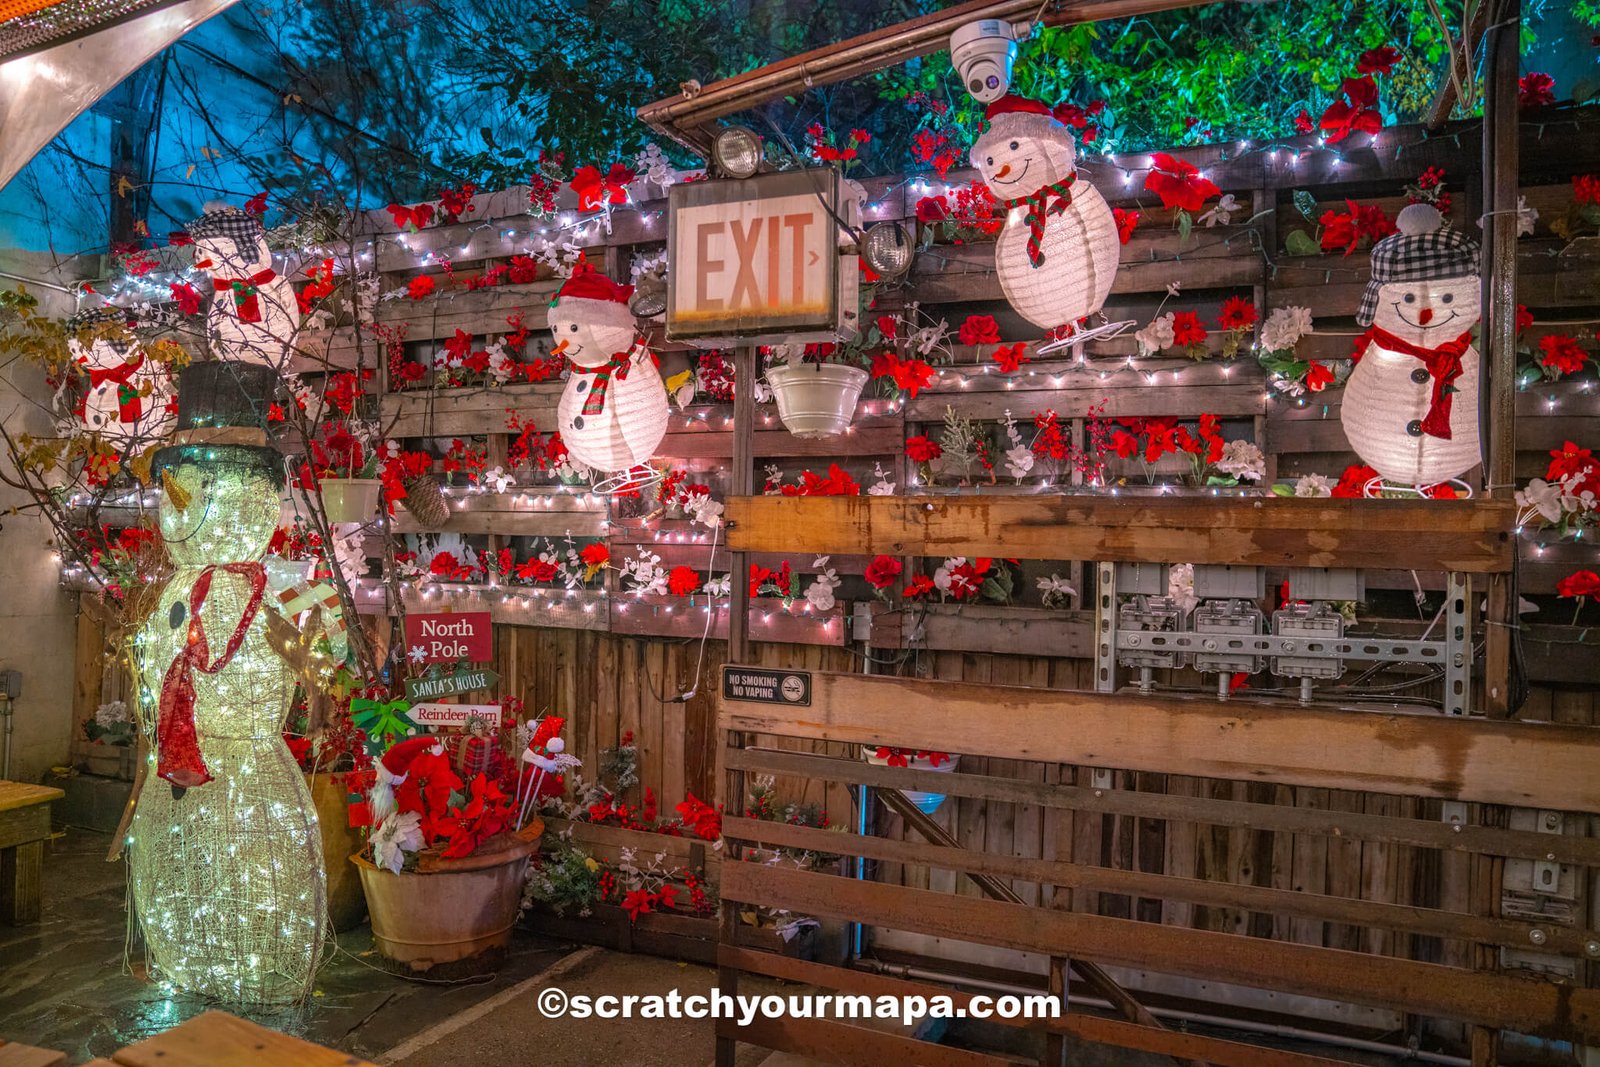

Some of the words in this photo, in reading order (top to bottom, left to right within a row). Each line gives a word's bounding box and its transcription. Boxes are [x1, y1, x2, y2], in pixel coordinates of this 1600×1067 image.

[696, 213, 814, 312] EXIT
[421, 619, 474, 637] North
[430, 641, 469, 658] Pole
[412, 679, 454, 698] SANTA'S
[456, 673, 487, 691] HOUSE
[729, 674, 740, 685] NO
[741, 676, 778, 687] SMOKING
[733, 686, 743, 696] NO
[745, 687, 773, 698] VAPING
[418, 708, 469, 720] Reindeer
